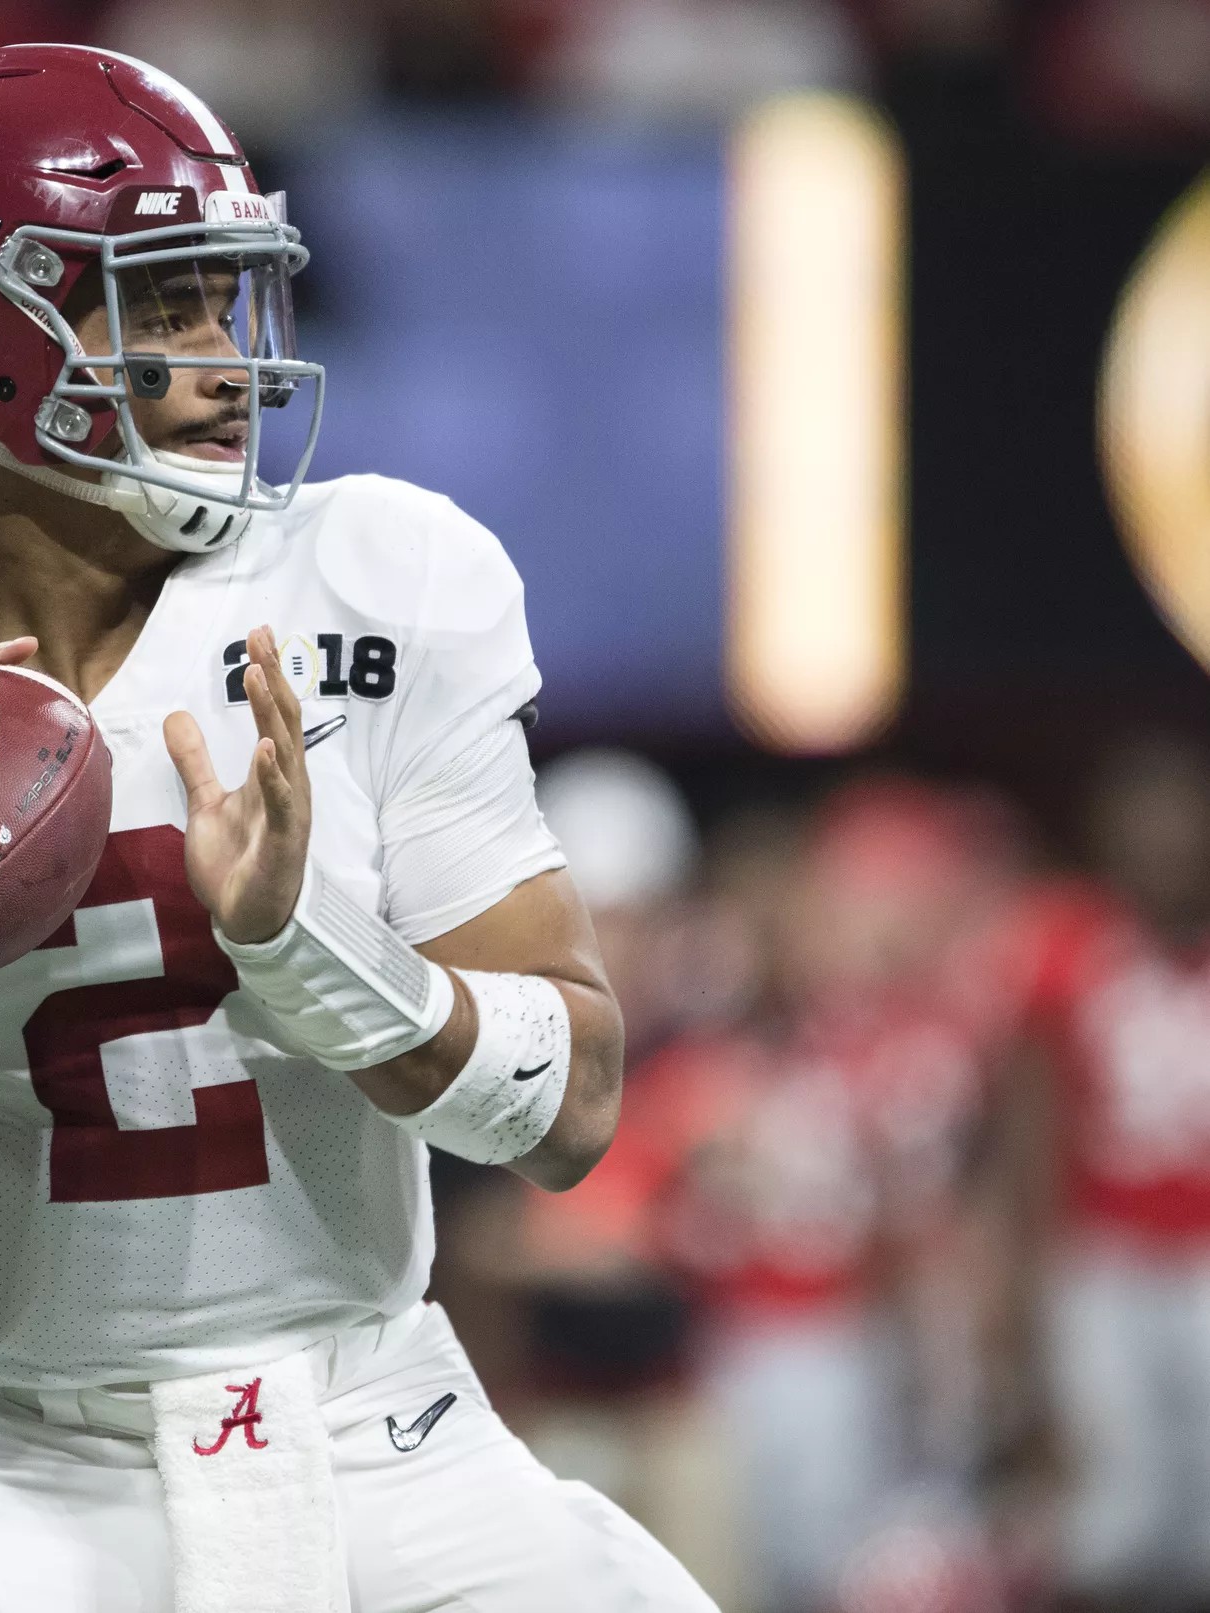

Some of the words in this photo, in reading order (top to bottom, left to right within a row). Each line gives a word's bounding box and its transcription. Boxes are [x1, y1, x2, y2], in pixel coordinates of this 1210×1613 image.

[134, 192, 182, 215] NIKE
[231, 201, 270, 220] BAMA
[22, 823, 271, 1204] 2
[192, 1377, 268, 1456] A
